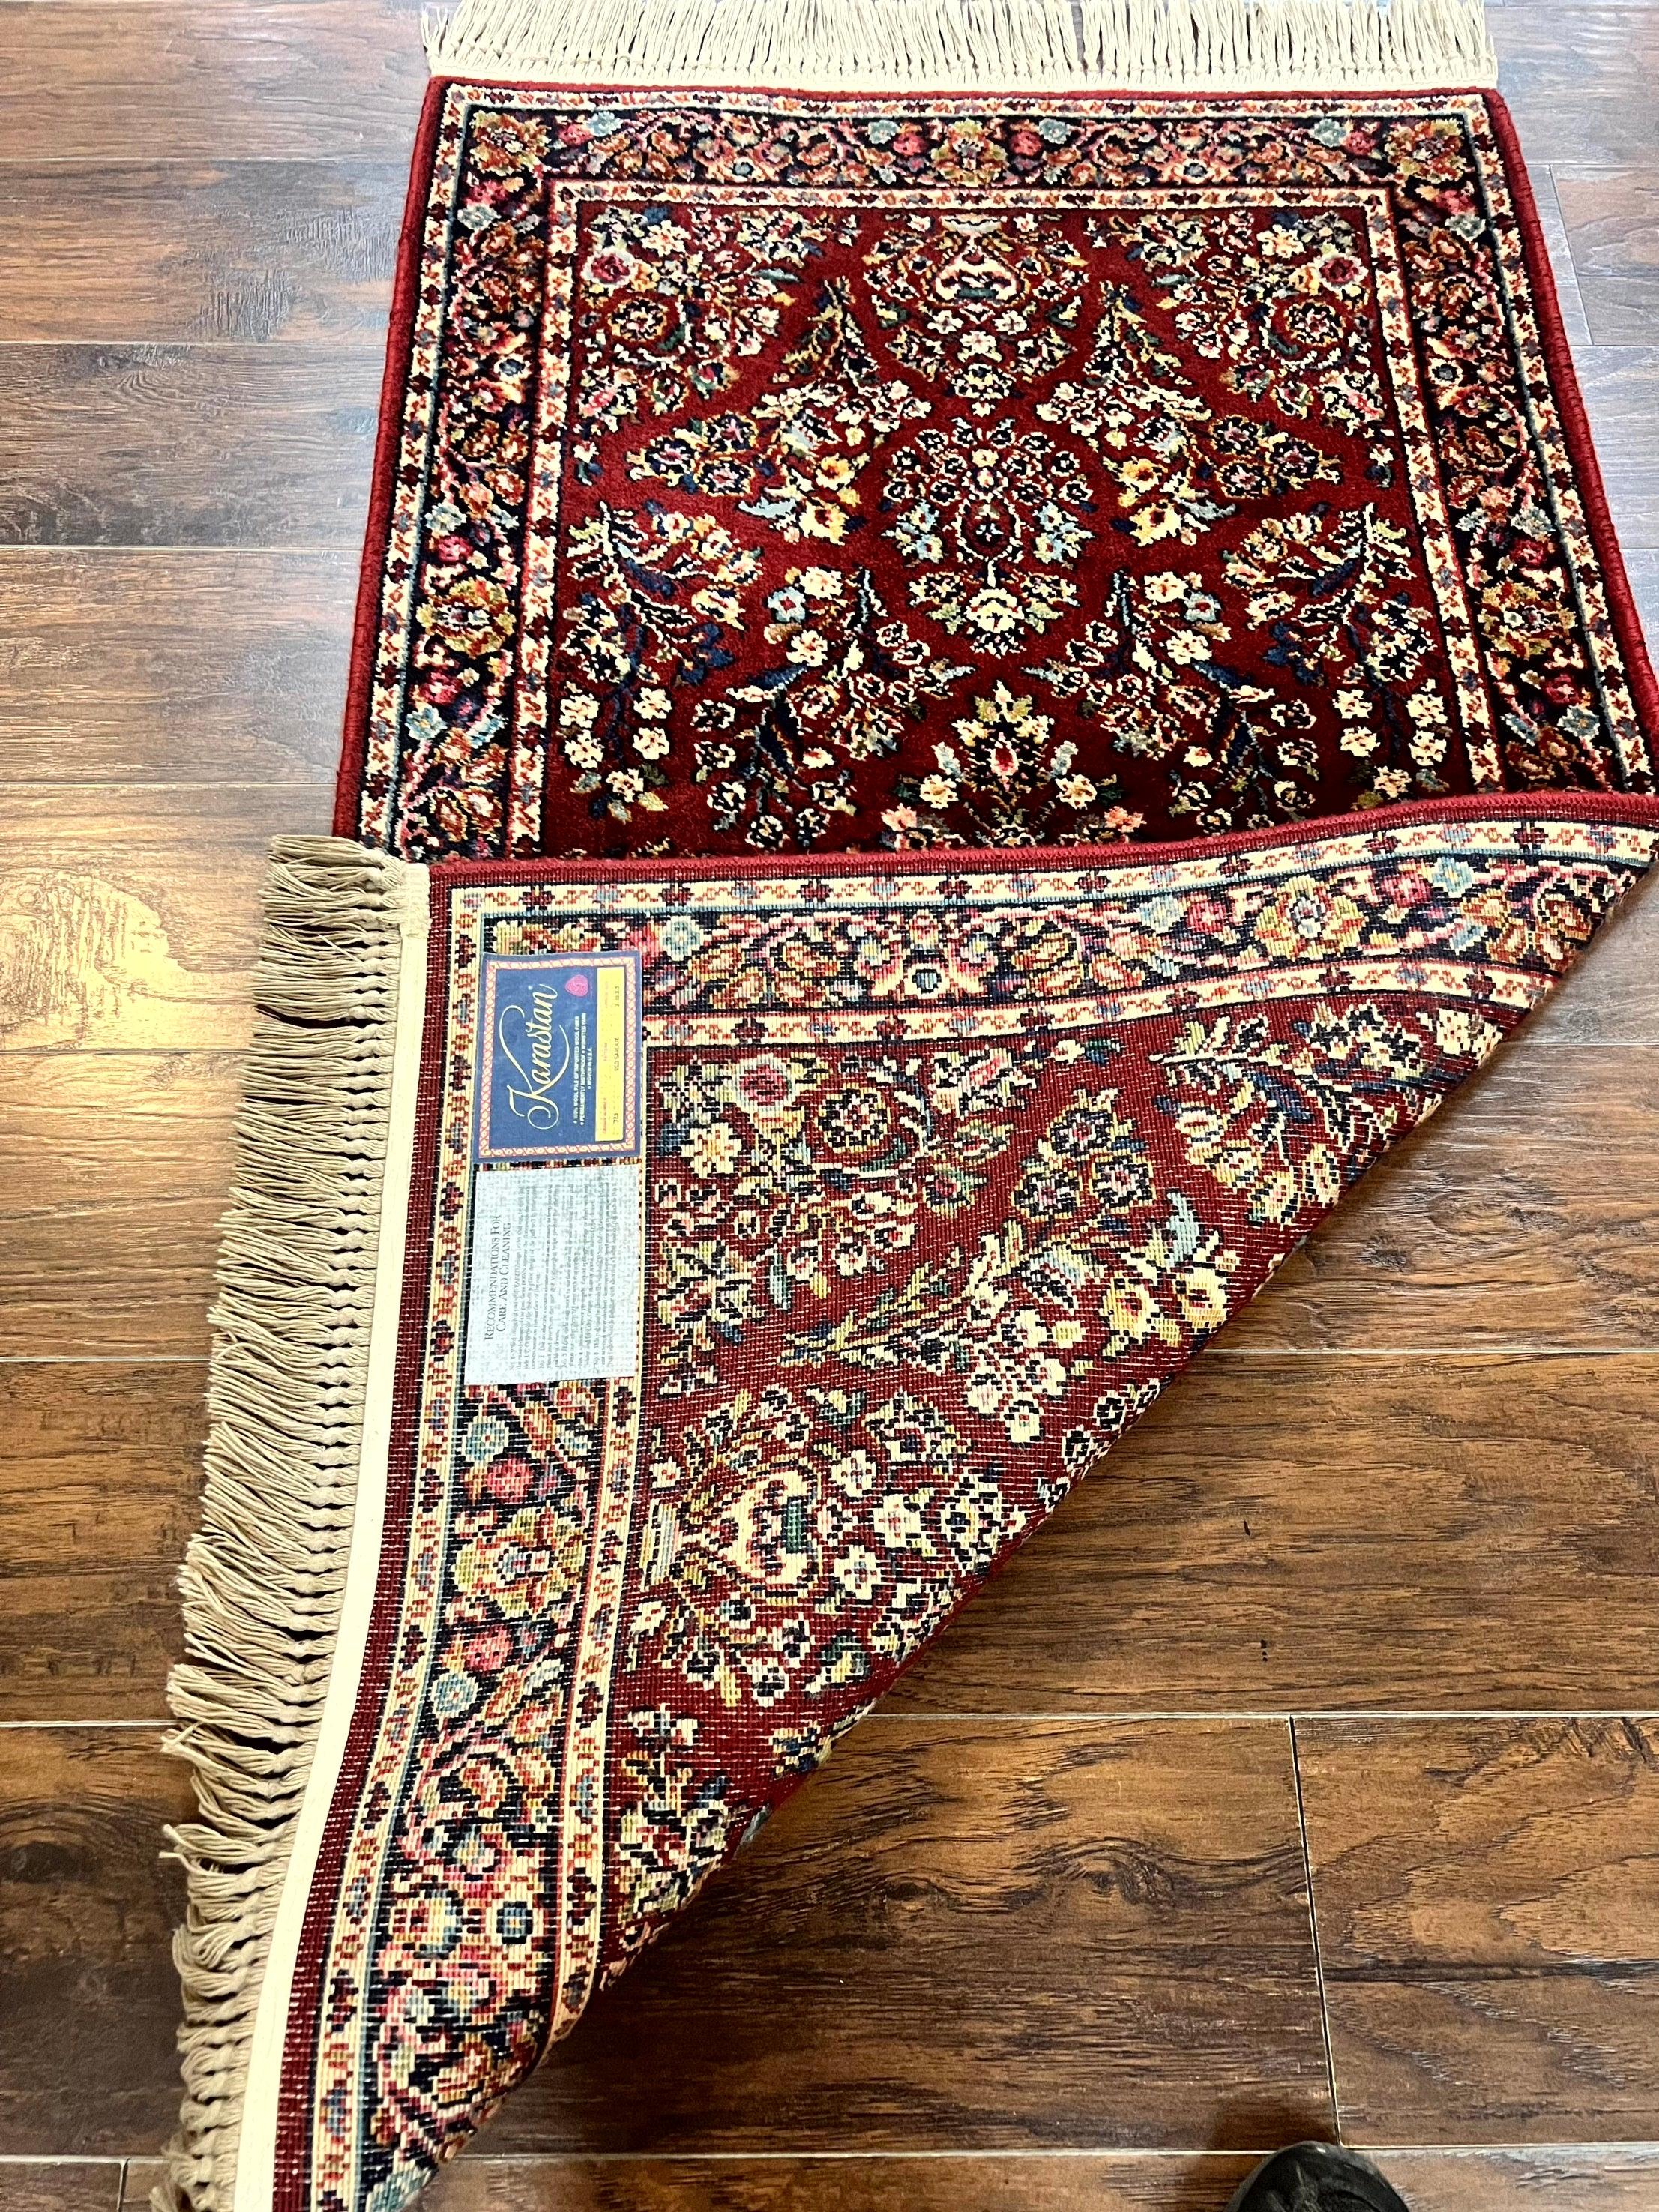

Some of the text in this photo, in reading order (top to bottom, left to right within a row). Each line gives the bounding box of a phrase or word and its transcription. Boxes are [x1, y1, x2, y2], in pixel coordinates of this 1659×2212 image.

[499, 983, 570, 1129] Karastan
[484, 1215, 501, 1340] RECOMMENDATIONS FOR
[496, 1223, 511, 1331] CARE AND CLEANING
